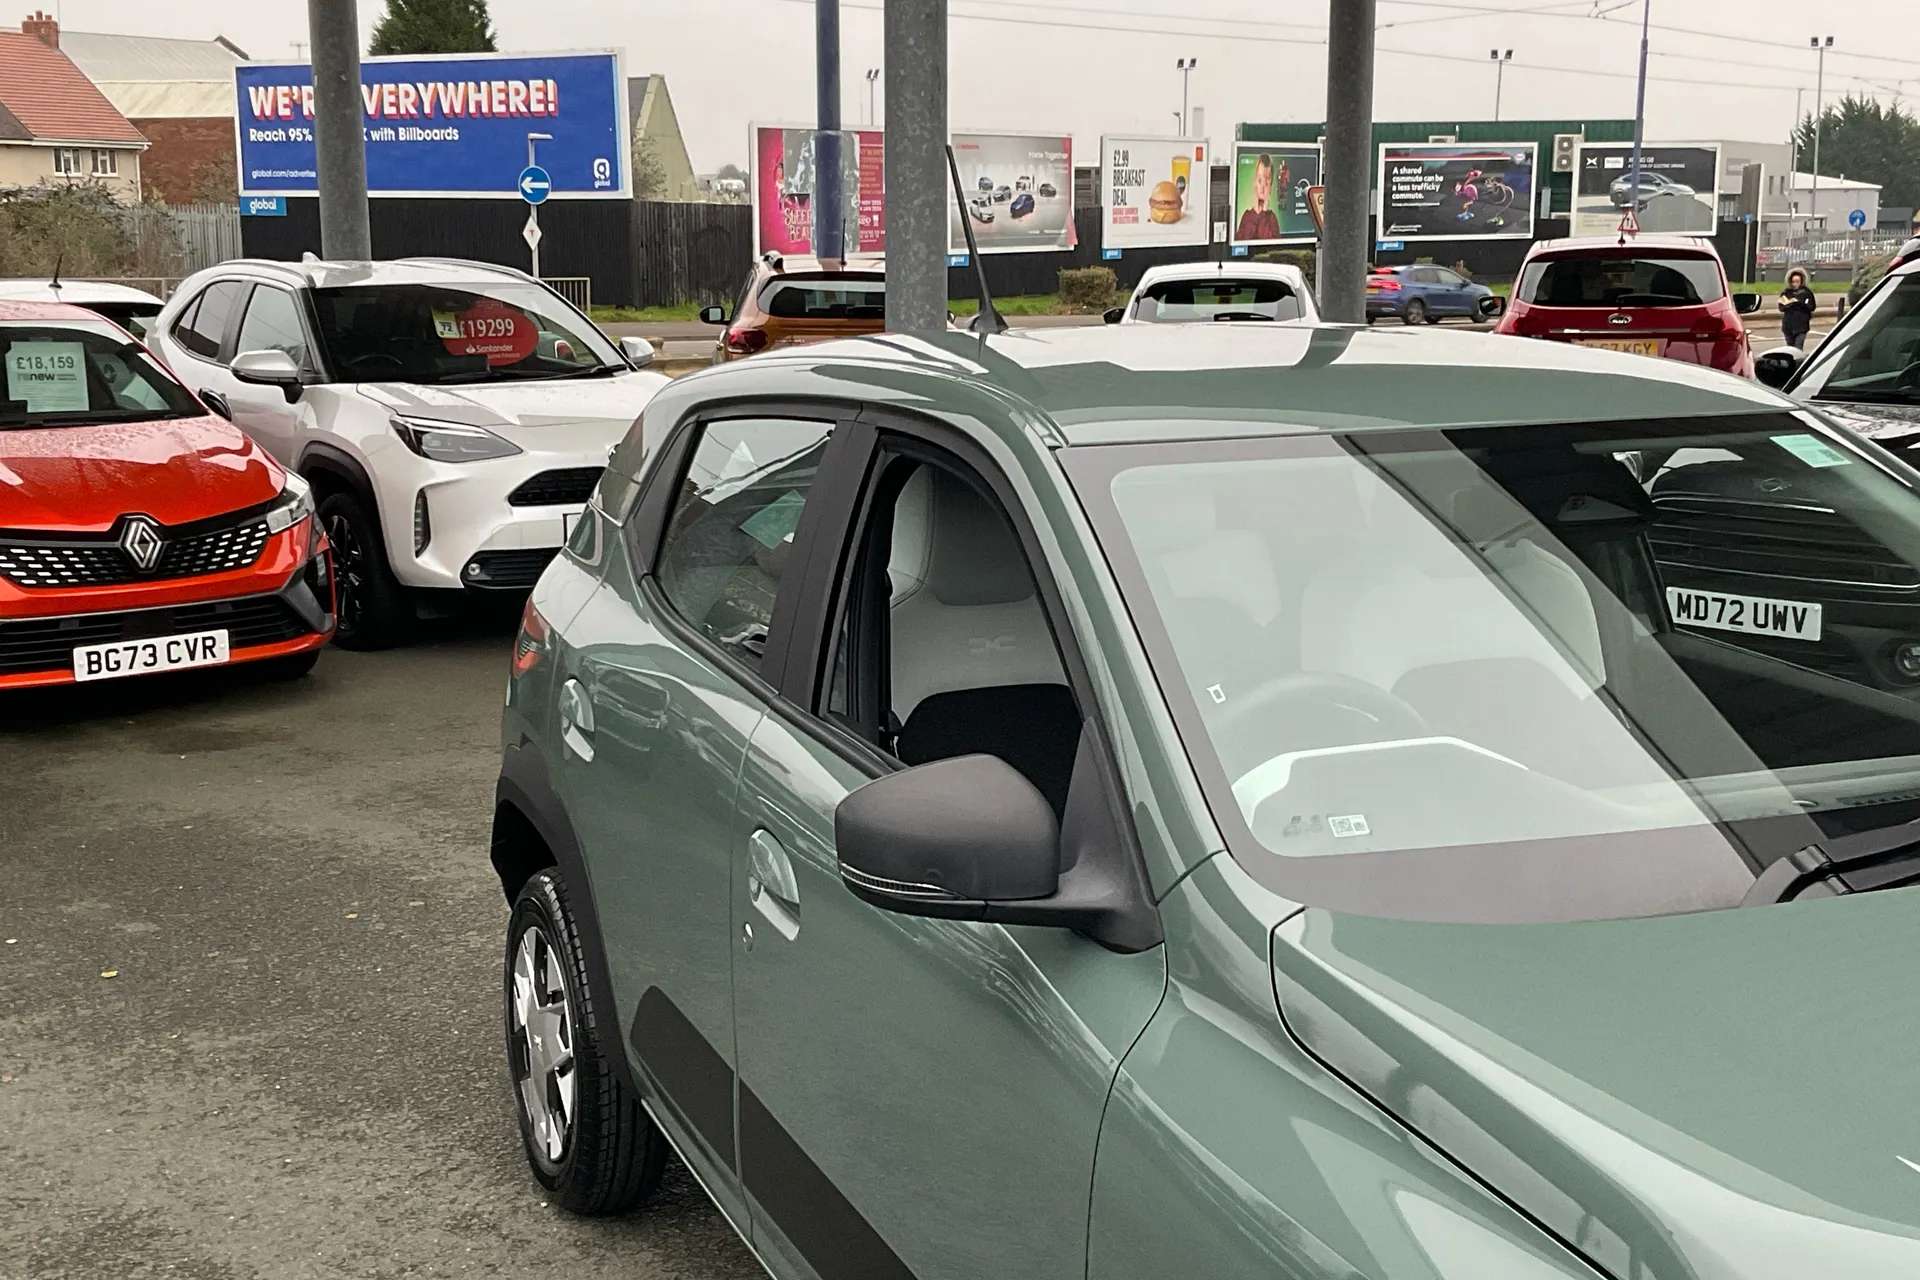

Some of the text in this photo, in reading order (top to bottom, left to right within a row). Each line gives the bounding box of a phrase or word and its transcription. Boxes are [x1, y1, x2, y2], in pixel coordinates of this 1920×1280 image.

[248, 79, 558, 119] WE'R VERYWHERE!
[249, 128, 313, 142] Reach 95%
[370, 127, 395, 141] with
[399, 126, 460, 141] Billboards
[1113, 149, 1129, 167] £2.99
[1113, 169, 1145, 187] BREAKFAST
[1392, 166, 1422, 175] A shared
[1392, 175, 1423, 183] commute
[1435, 173, 1444, 182] be
[1397, 183, 1410, 191] less
[1411, 182, 1441, 192] trafficky
[1112, 189, 1127, 206] DEAL
[1392, 192, 1424, 200] commute.
[250, 198, 277, 214] global
[459, 318, 515, 338] £19299
[476, 345, 513, 353] Santander
[16, 356, 75, 371] £18,159
[1676, 592, 1808, 634] MD72 UWV
[86, 635, 218, 676] BG73 CVR
